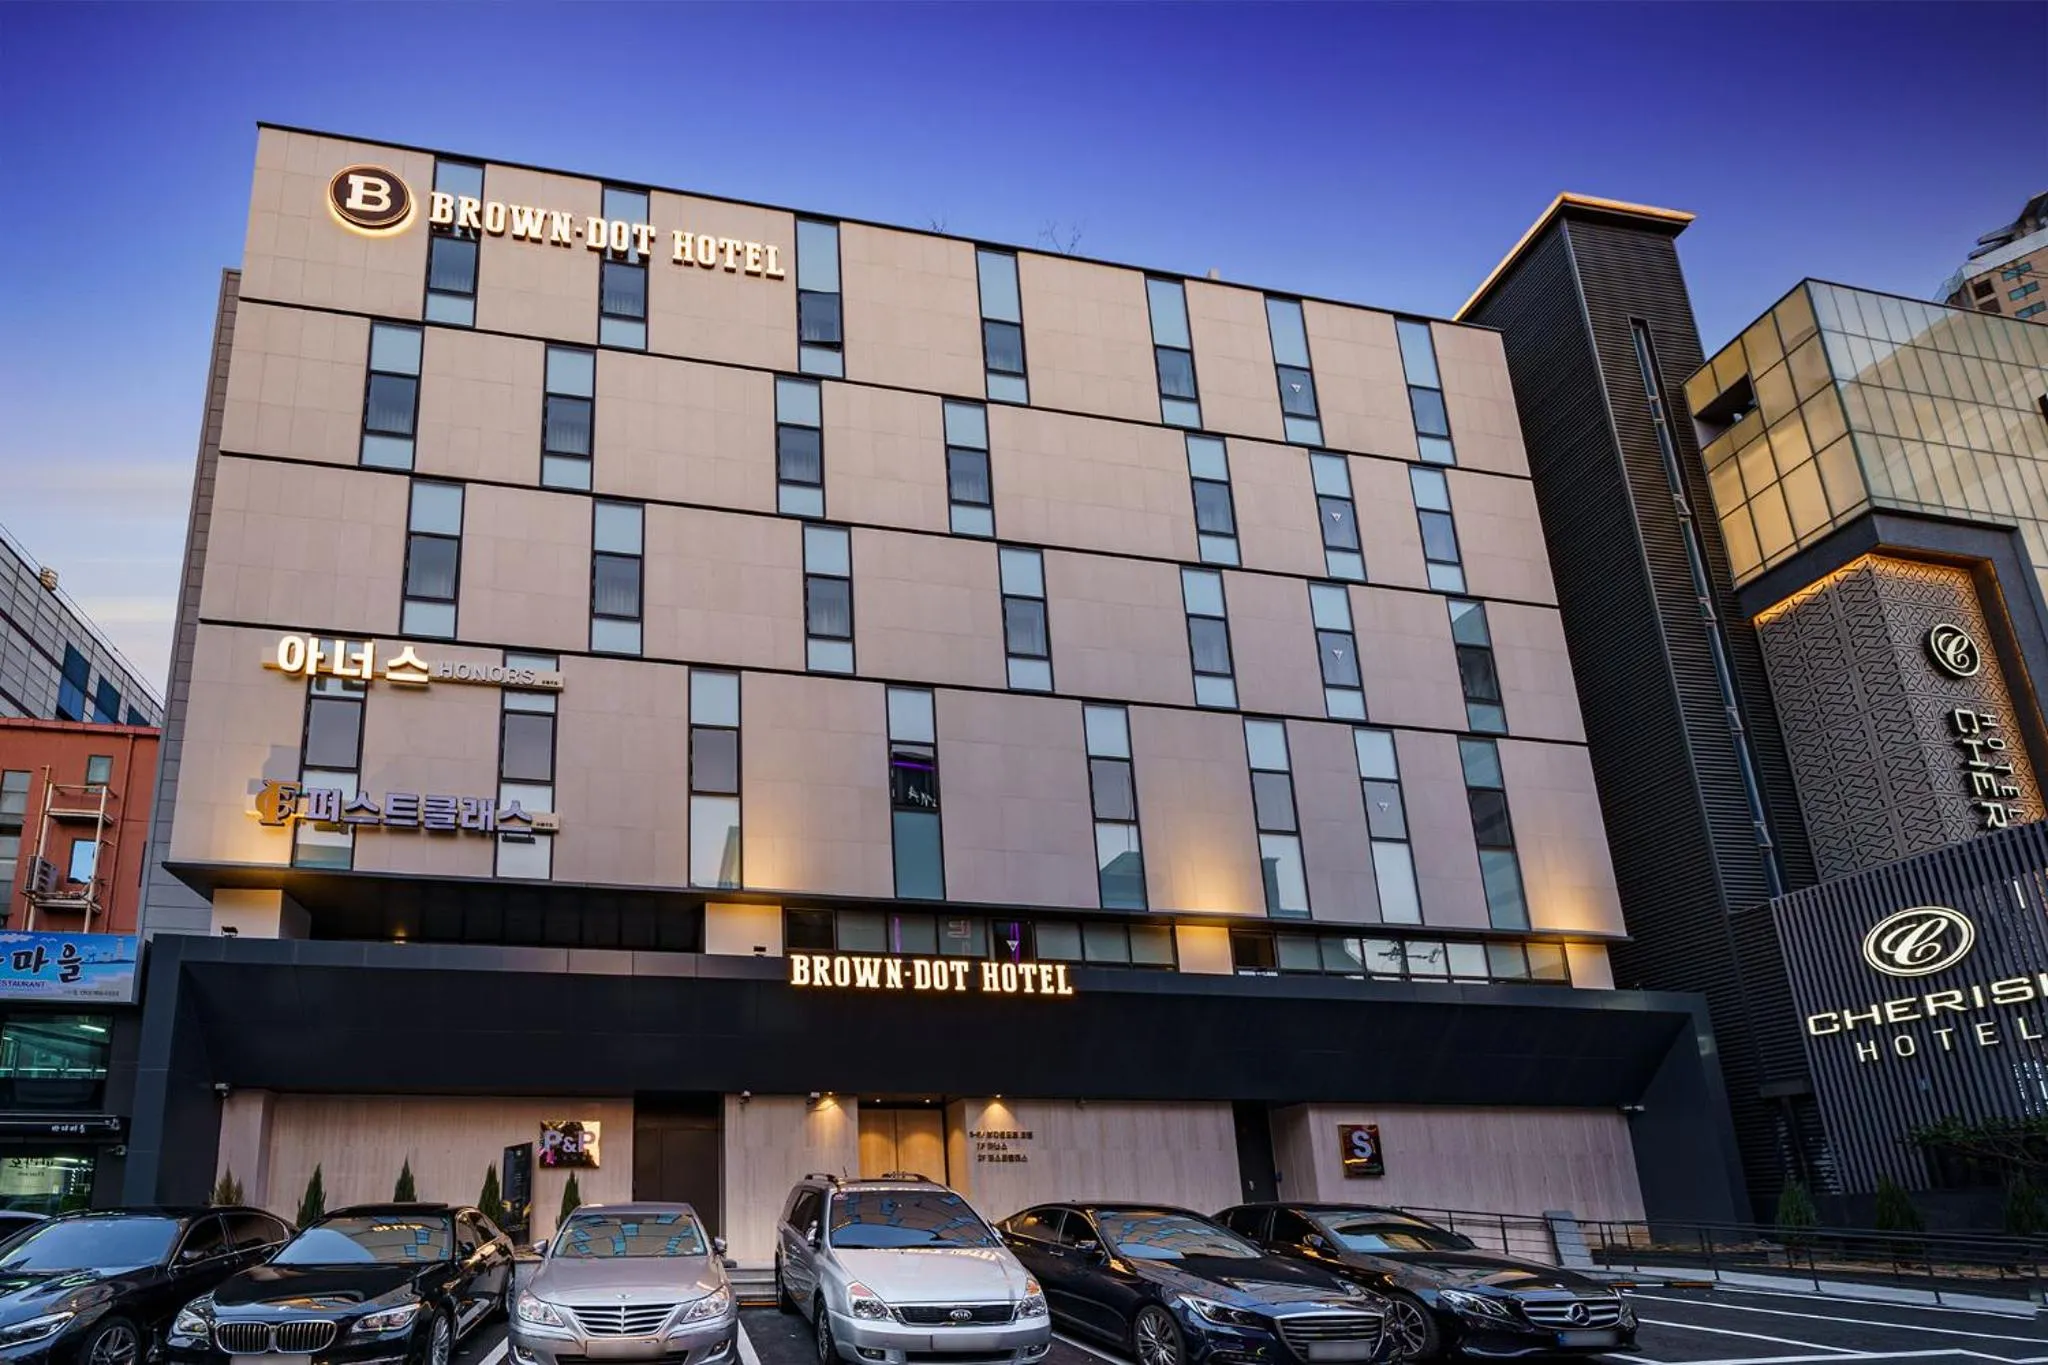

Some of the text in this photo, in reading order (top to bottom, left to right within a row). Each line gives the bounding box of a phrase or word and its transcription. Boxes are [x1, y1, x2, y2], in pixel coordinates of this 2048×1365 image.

[346, 174, 391, 212] B
[672, 229, 785, 278] HOTEL
[277, 635, 536, 685] 아너스 HONORS
[1980, 713, 2024, 819] HOTEL
[305, 788, 533, 834] 퍼스트클래스
[980, 961, 1073, 994] HOTEL
[1855, 1016, 2043, 1063] HOTEL
[543, 1130, 596, 1153] P&P
[1351, 1130, 1373, 1158] S
